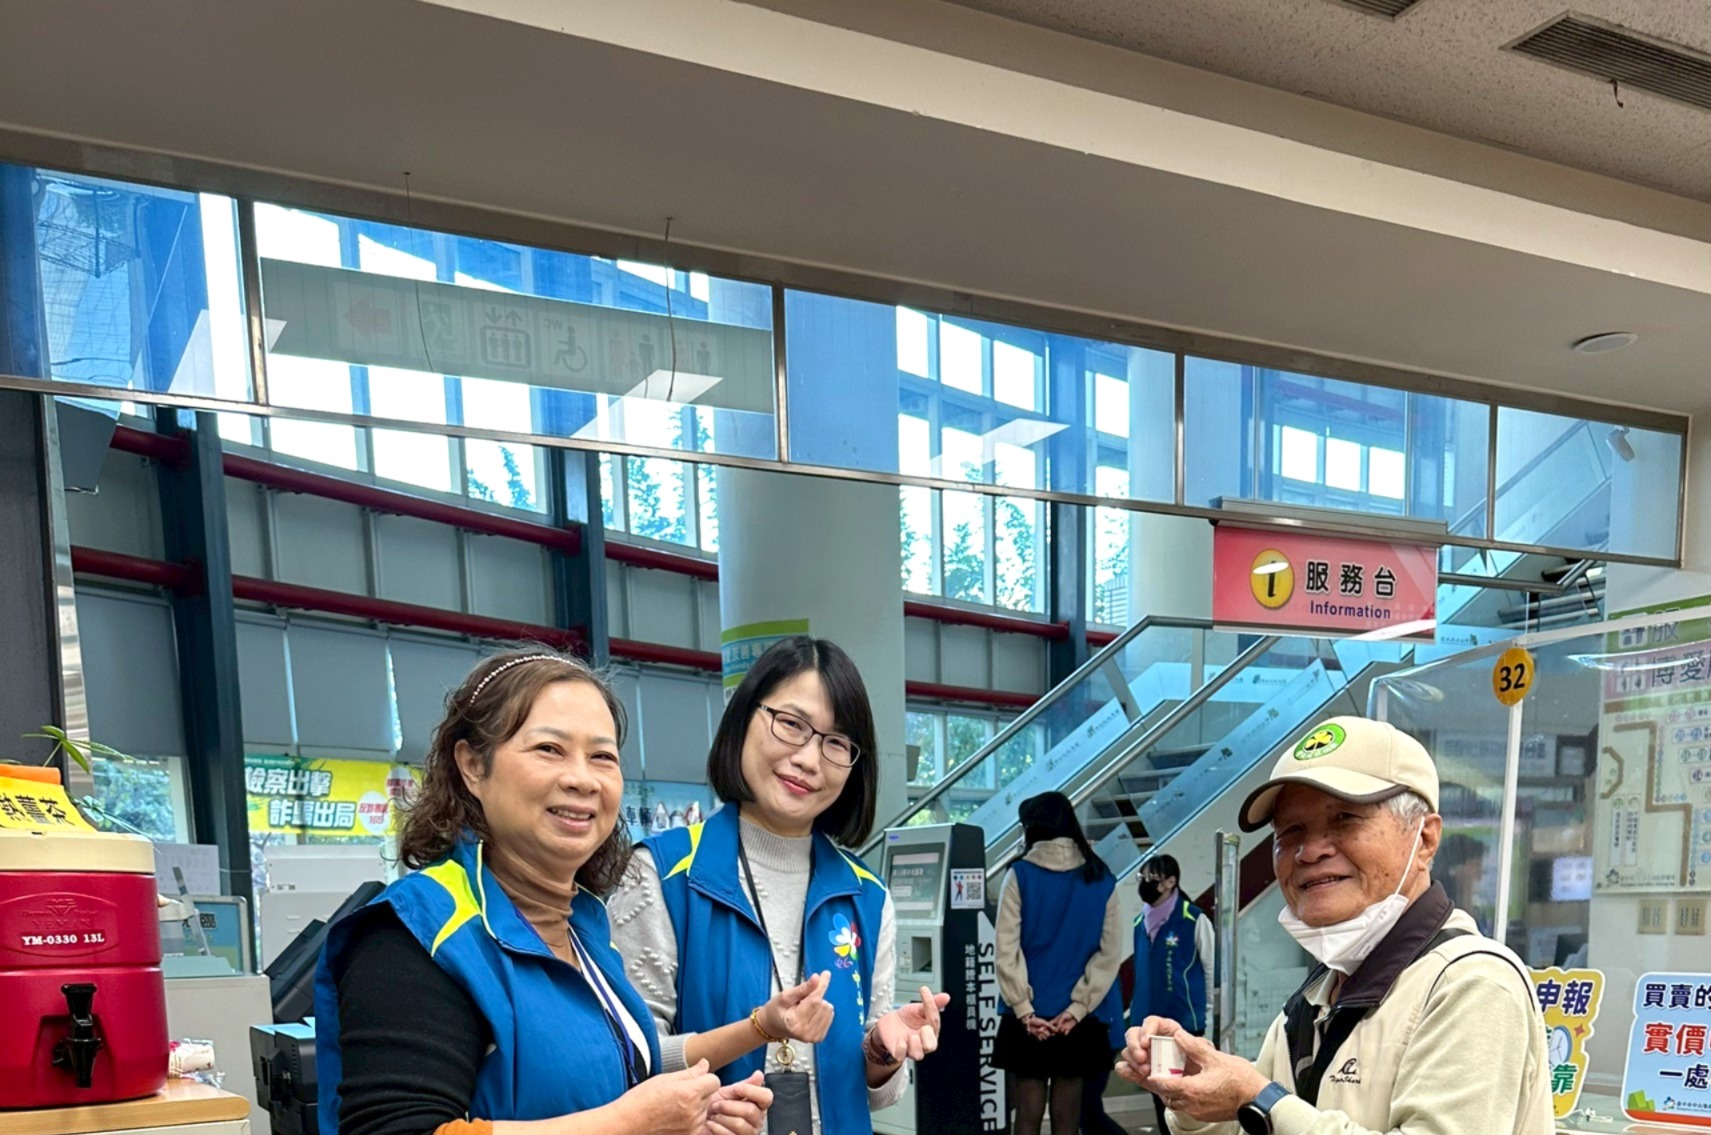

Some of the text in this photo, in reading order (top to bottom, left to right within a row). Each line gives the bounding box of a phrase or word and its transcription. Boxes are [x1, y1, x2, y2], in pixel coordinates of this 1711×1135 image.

[1305, 560, 1397, 598] 服務台
[1310, 600, 1392, 620] Information
[1498, 662, 1527, 693] 32
[1651, 648, 1711, 688] 博愛
[269, 799, 357, 829] 詐騙出局
[21, 932, 106, 946] YM-0330 13L
[1536, 979, 1594, 1016] 申報
[978, 942, 999, 1132] SELF SERVICE
[1643, 1022, 1711, 1056] 實價
[1659, 1063, 1710, 1089] 一處
